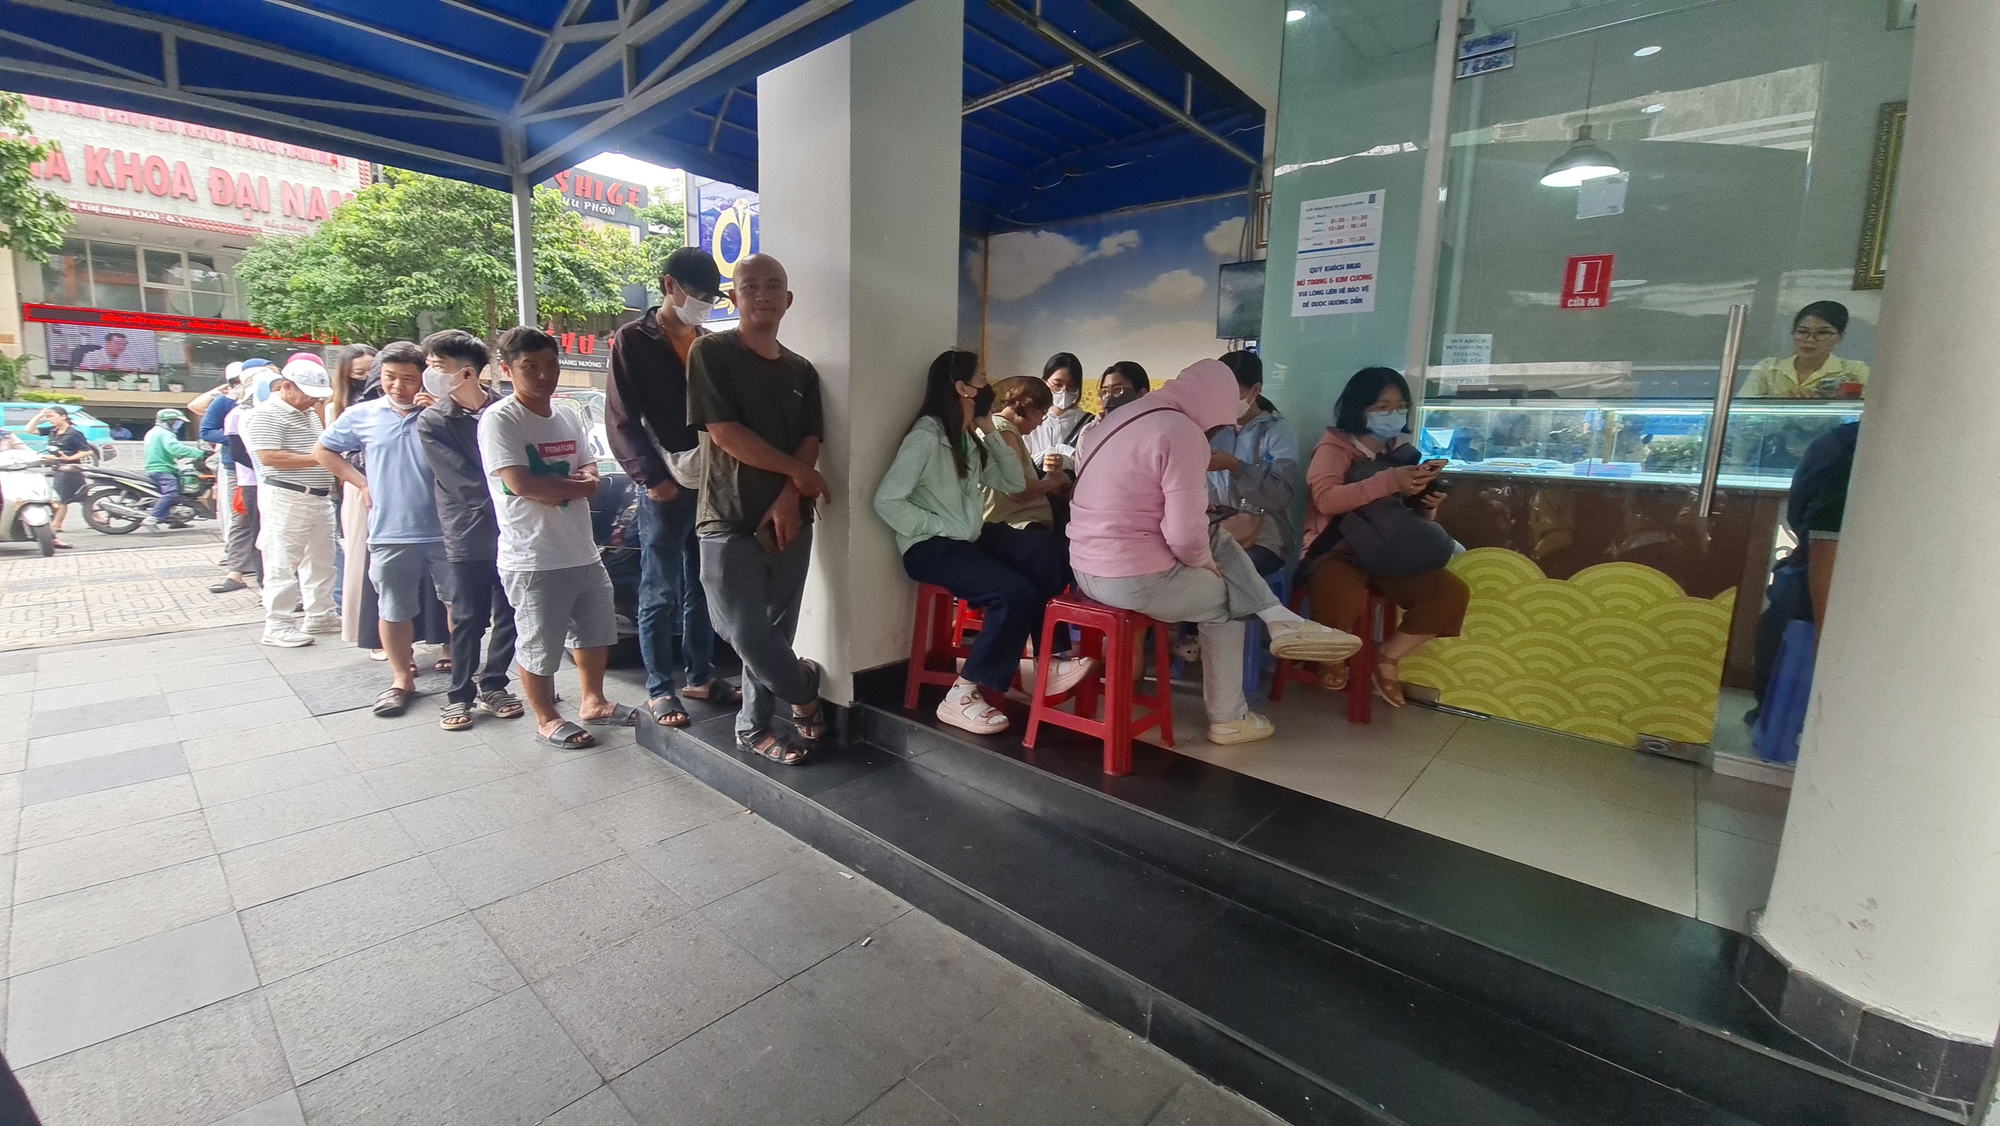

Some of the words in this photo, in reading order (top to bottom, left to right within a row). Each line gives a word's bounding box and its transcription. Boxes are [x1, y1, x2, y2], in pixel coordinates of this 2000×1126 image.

[84, 144, 197, 201] KHOA
[208, 166, 271, 220] ĐẠI
[555, 170, 641, 208] SHIGE
[132, 209, 160, 221] KHAI
[1567, 296, 1586, 307] CỬA
[1587, 297, 1600, 306] RA
[544, 443, 575, 454] PREMIUM
